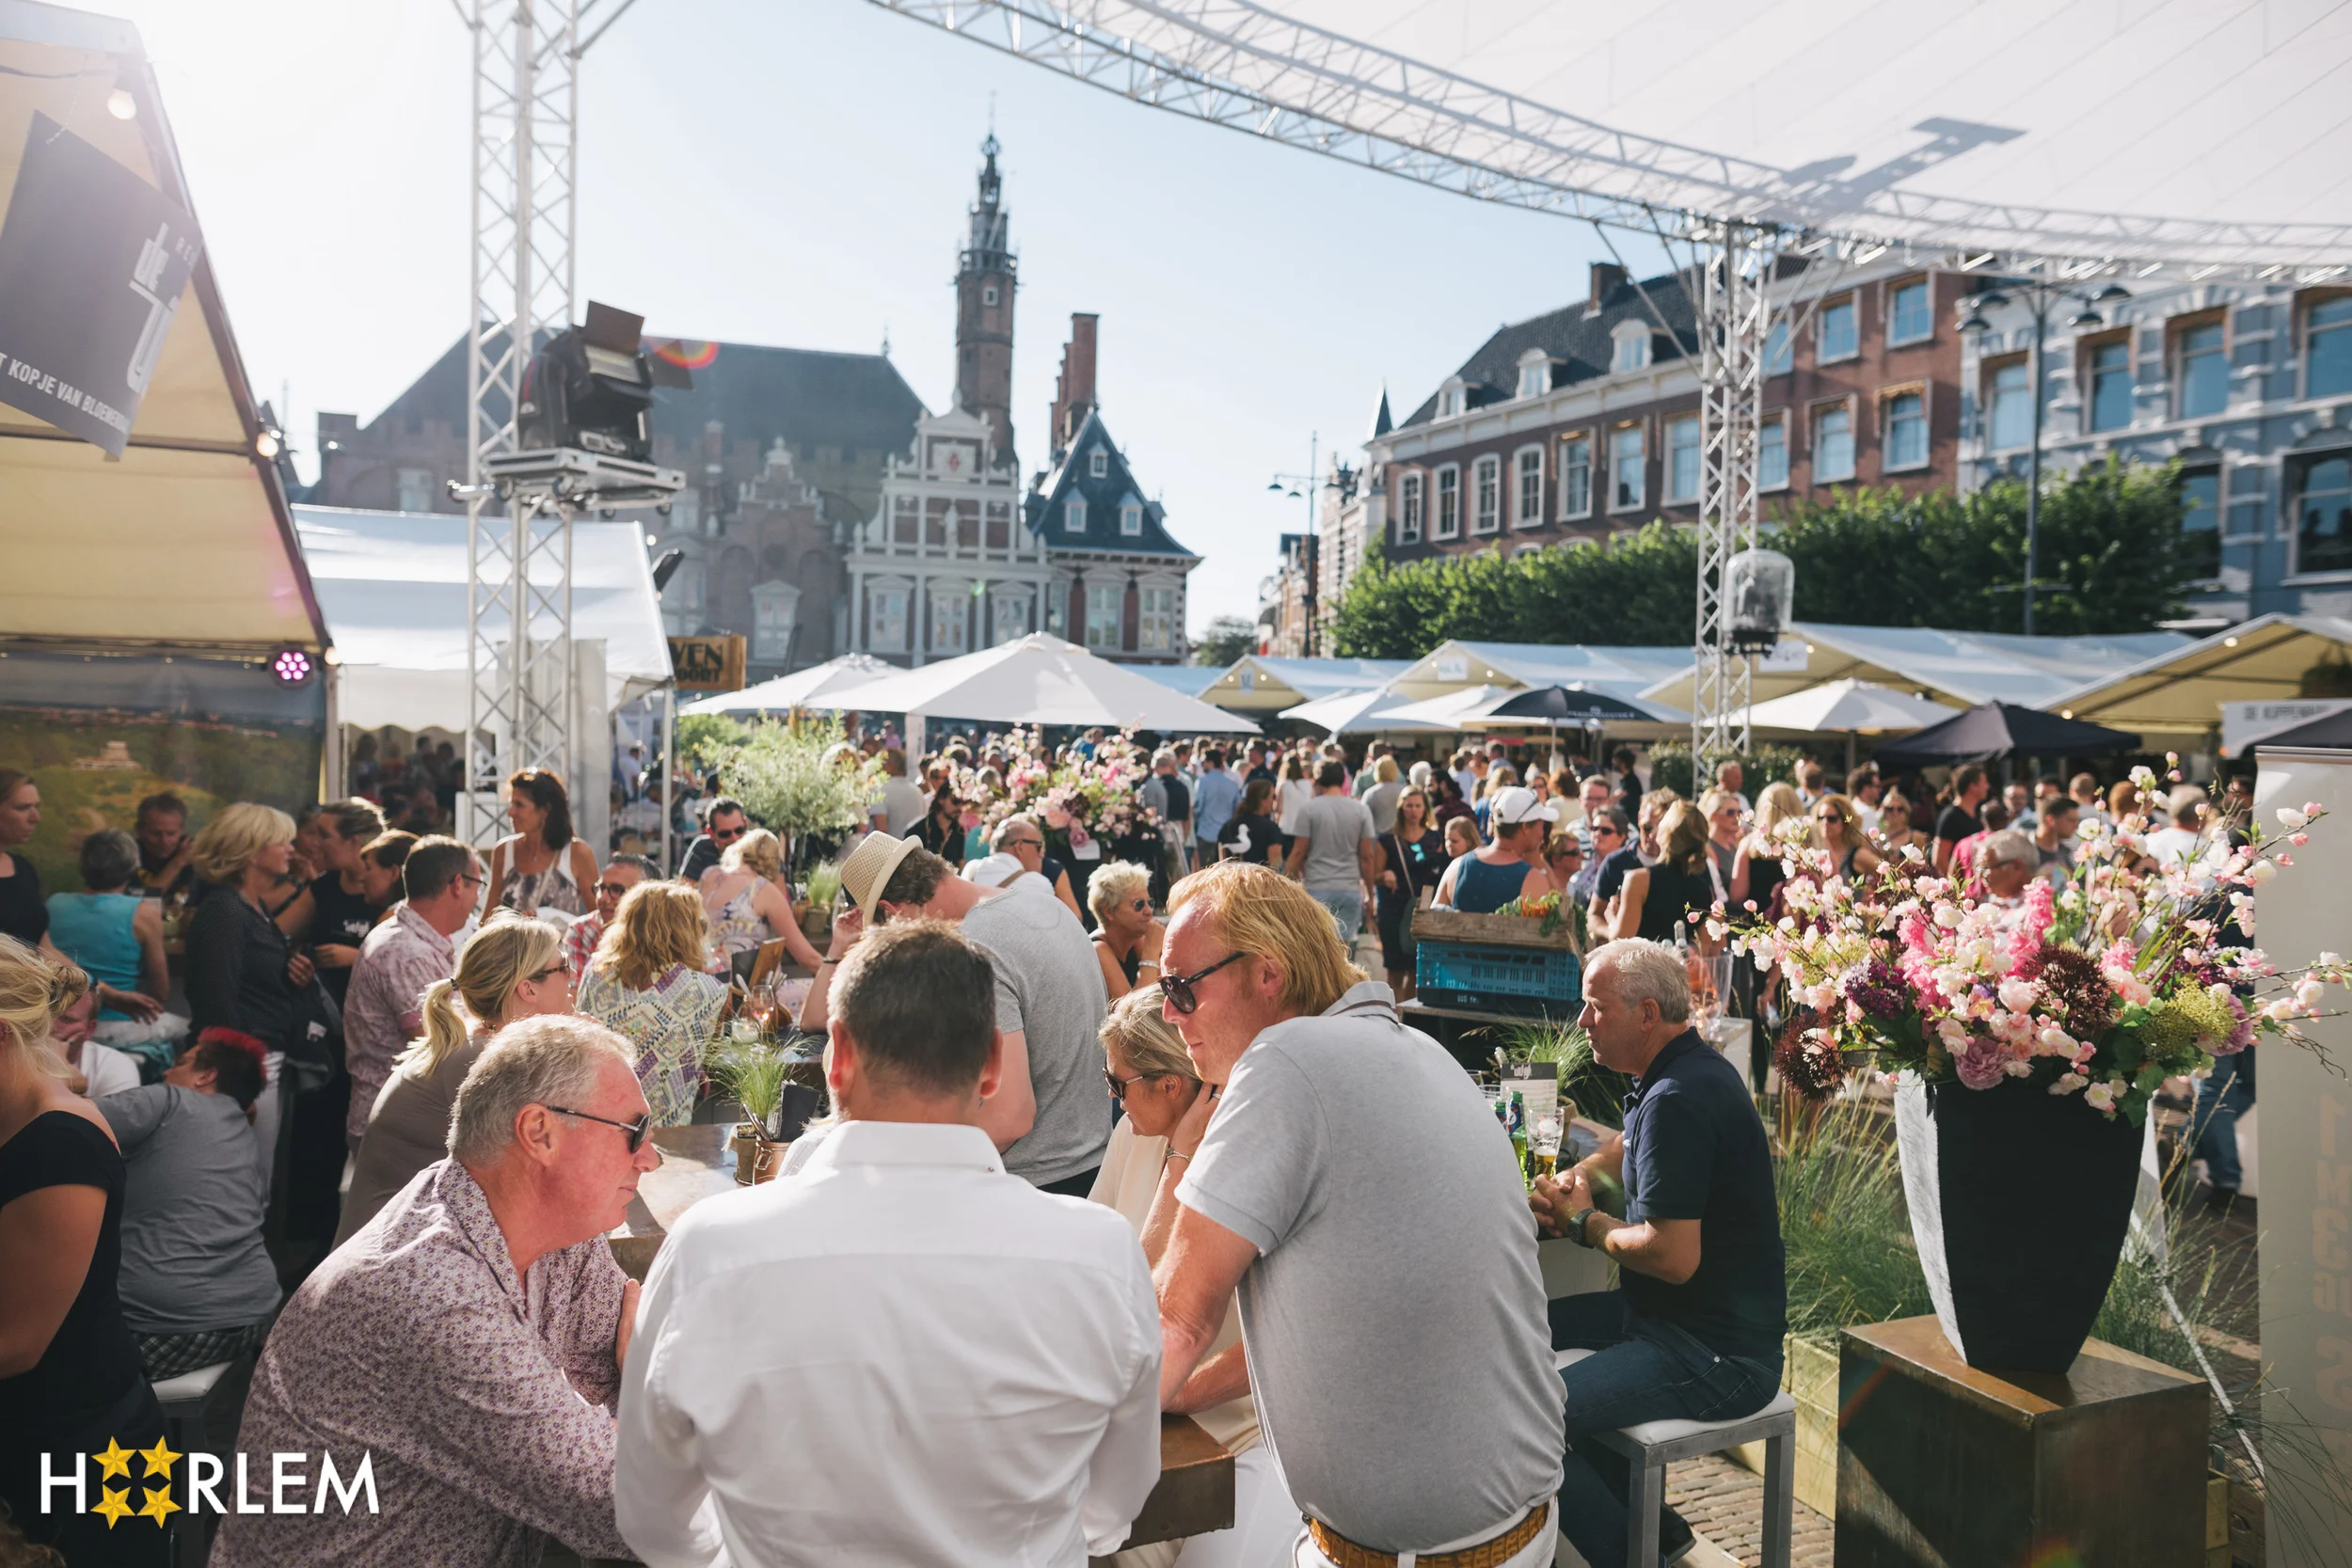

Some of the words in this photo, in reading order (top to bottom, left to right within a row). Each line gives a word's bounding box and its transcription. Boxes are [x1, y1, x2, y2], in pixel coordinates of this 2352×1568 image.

[8, 358, 57, 395] KOPJE
[56, 380, 84, 407] VAN
[81, 394, 131, 435] BLOEMEN
